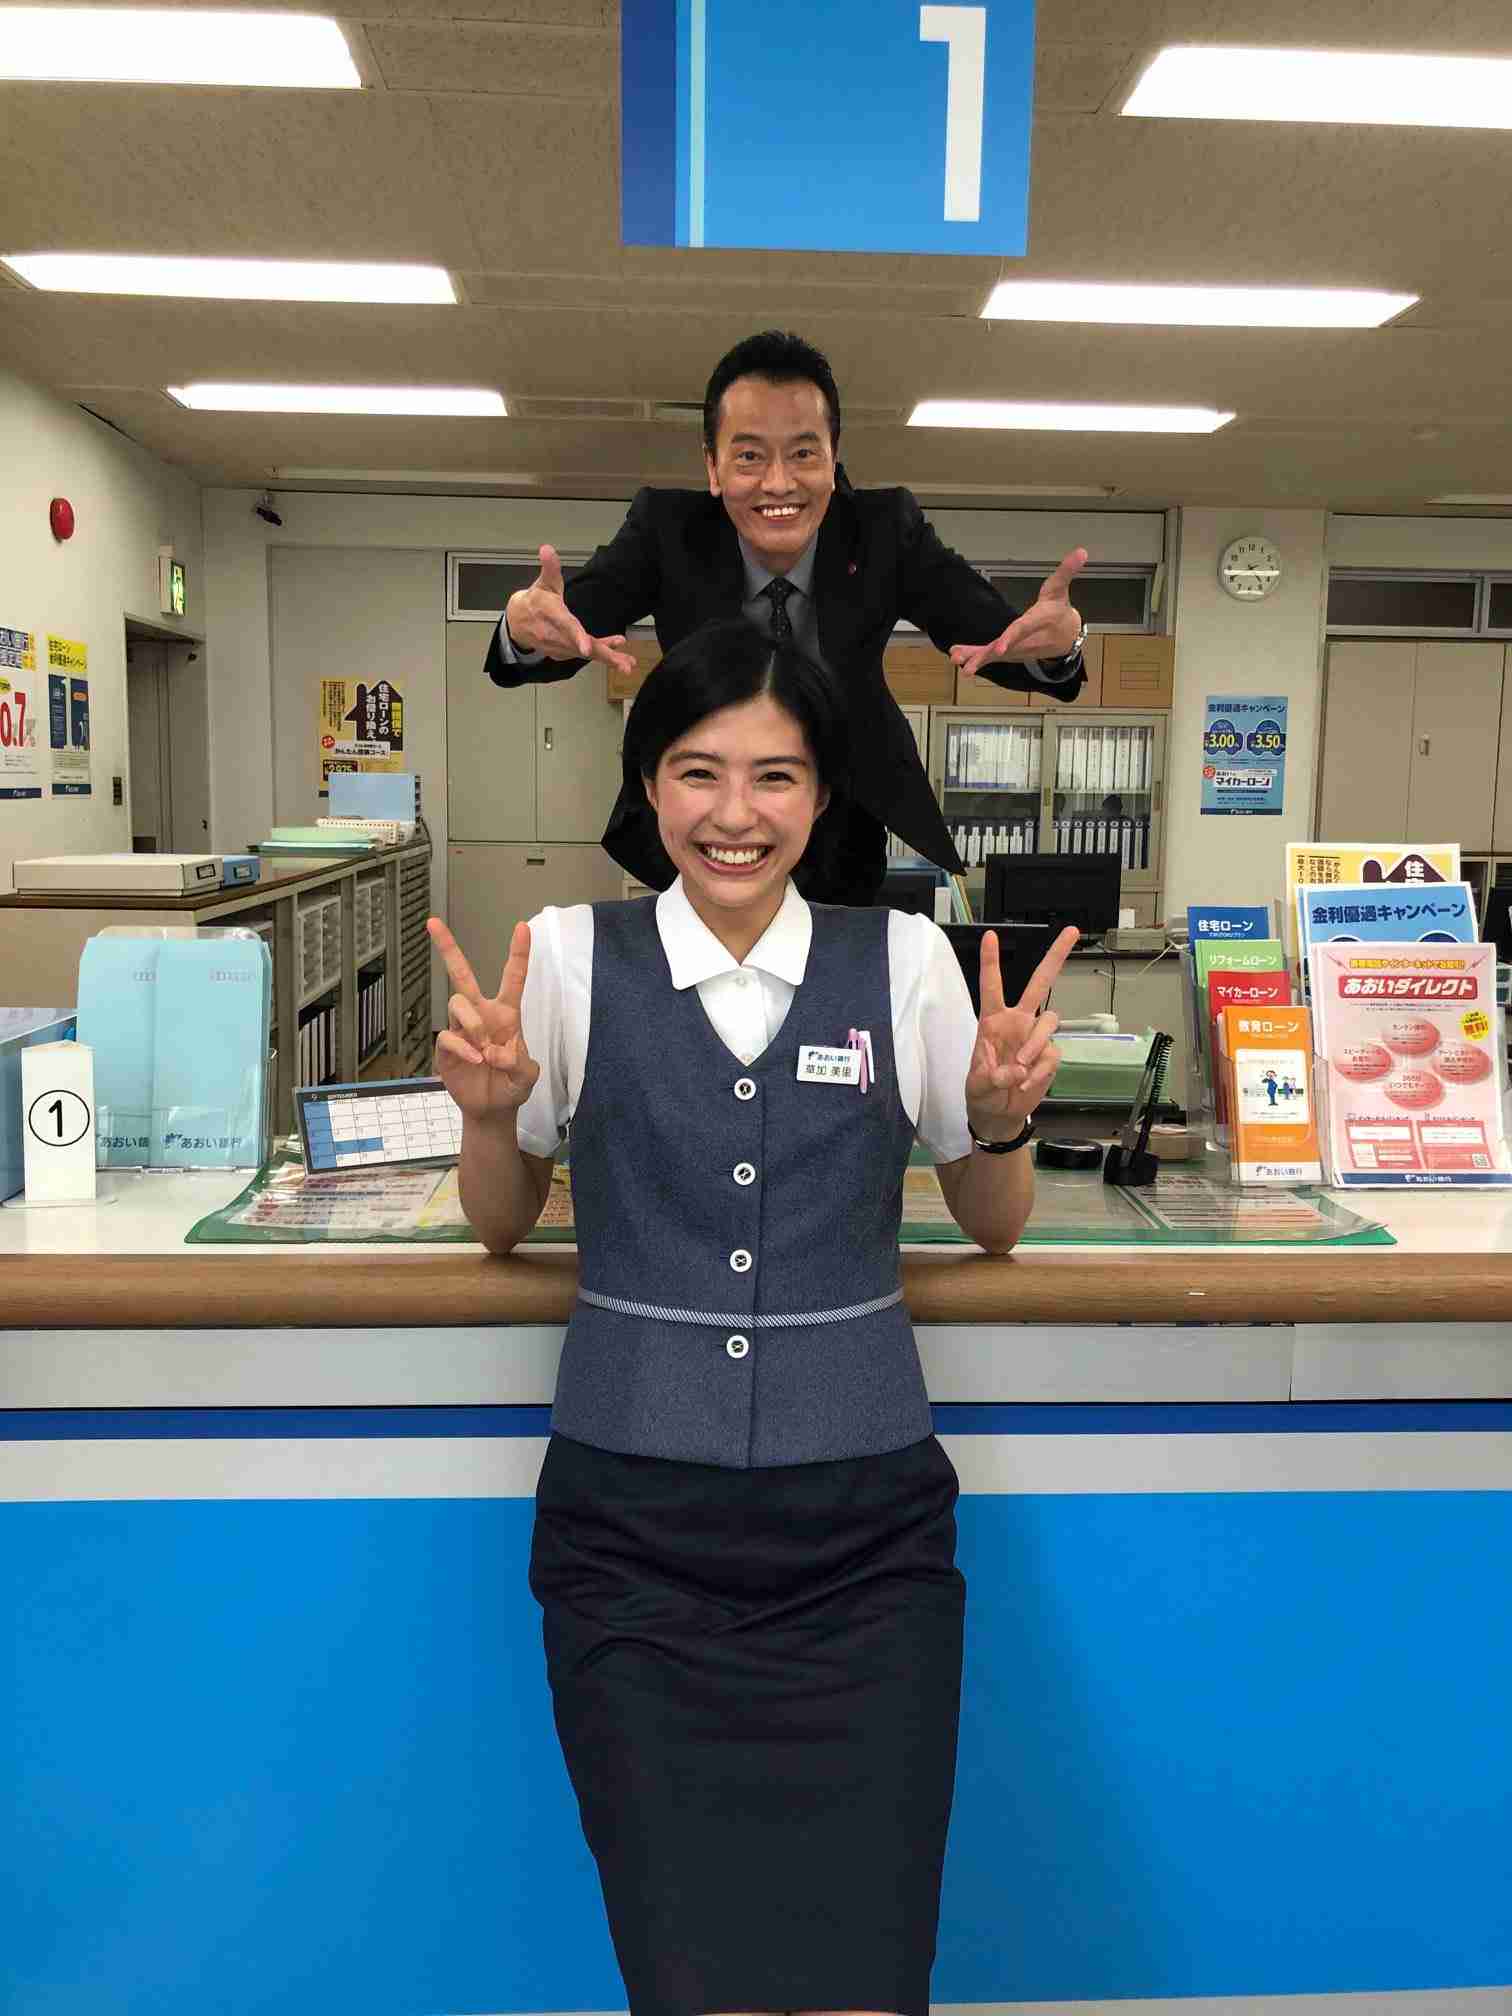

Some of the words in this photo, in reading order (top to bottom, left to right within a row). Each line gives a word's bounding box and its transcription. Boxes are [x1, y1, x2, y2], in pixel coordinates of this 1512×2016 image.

[920, 5, 986, 222] 1
[1207, 703, 1286, 713] 金利優遇キャンペーン
[1216, 777, 1271, 786] マイカーローン
[1312, 903, 1466, 924] 金利優遇キャンペーン
[1198, 919, 1253, 932] 住宅ローン
[1209, 954, 1277, 966] リフォームローン
[1216, 986, 1278, 998] マイカーローン
[1344, 977, 1474, 997] あおいダイレクト
